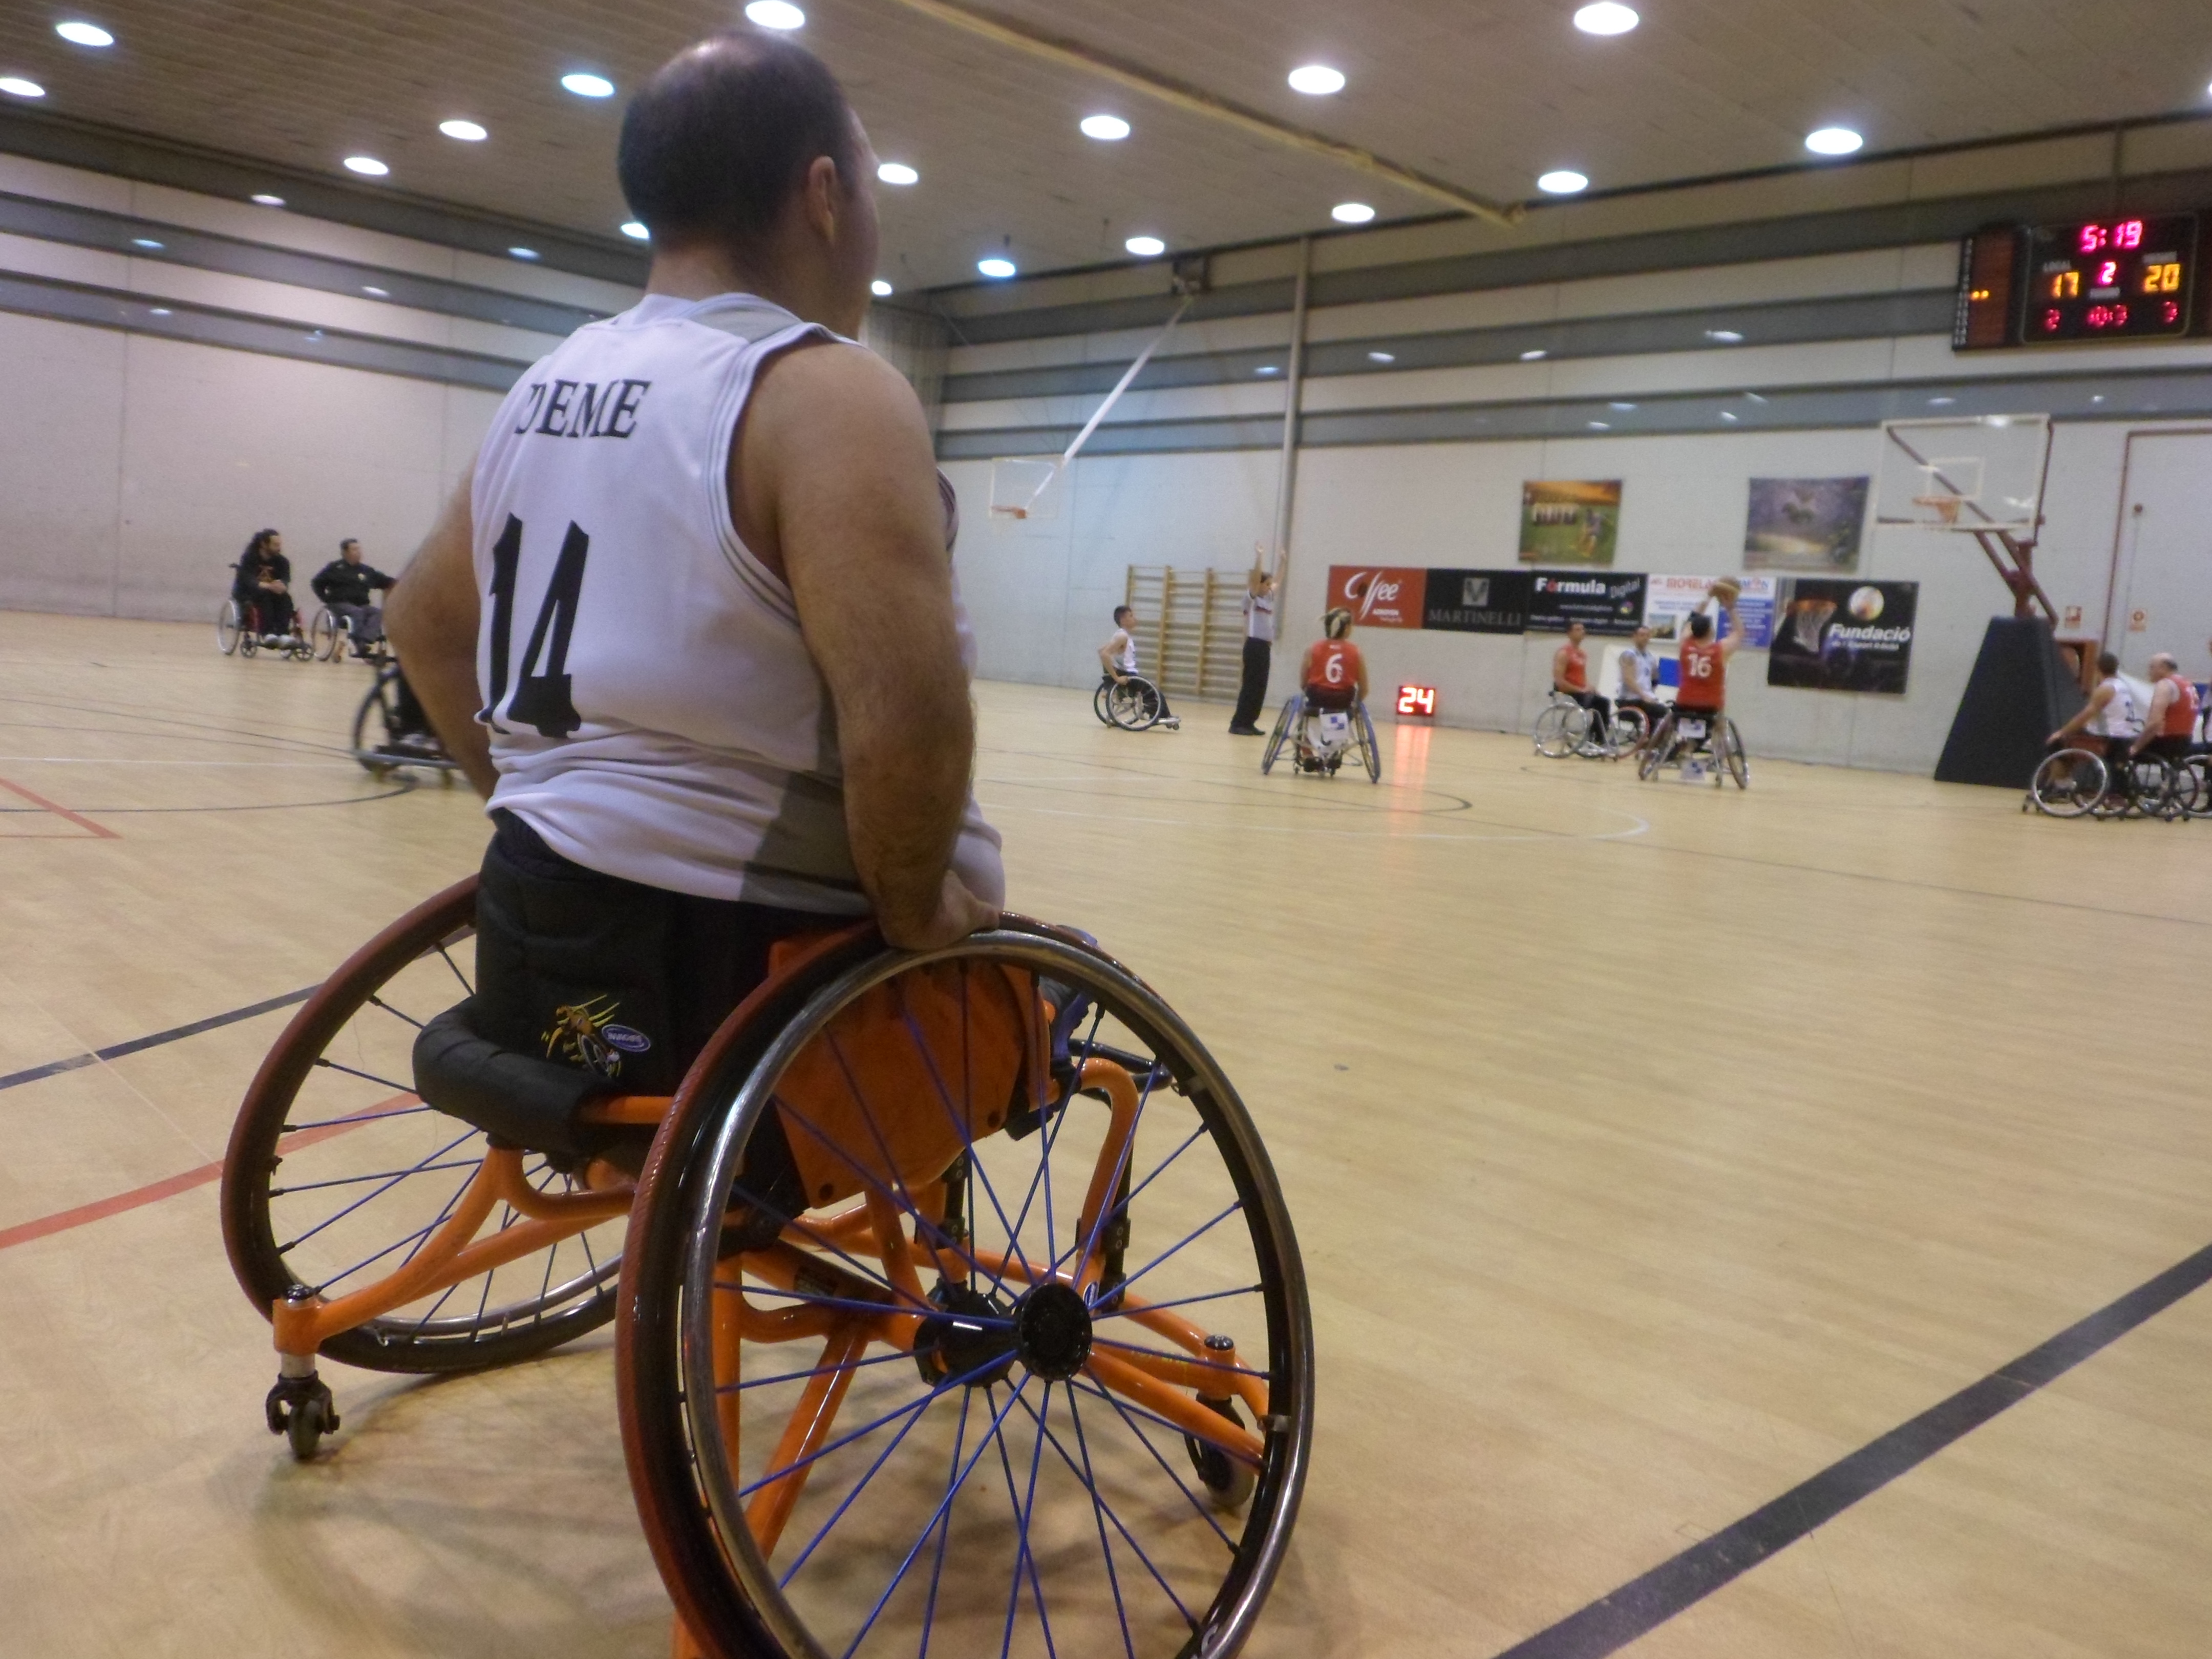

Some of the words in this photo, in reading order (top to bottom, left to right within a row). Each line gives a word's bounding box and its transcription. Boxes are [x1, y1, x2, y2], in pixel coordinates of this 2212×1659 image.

[2081, 220, 2142, 251] 5:19
[2052, 272, 2079, 298] 17
[2101, 261, 2116, 284] 2
[2145, 264, 2180, 292] 20
[478, 512, 589, 738] 14
[1828, 623, 1911, 642] Fundació
[1325, 653, 1343, 683] 6
[1688, 653, 1712, 677] 16
[1398, 687, 1434, 713] 24
